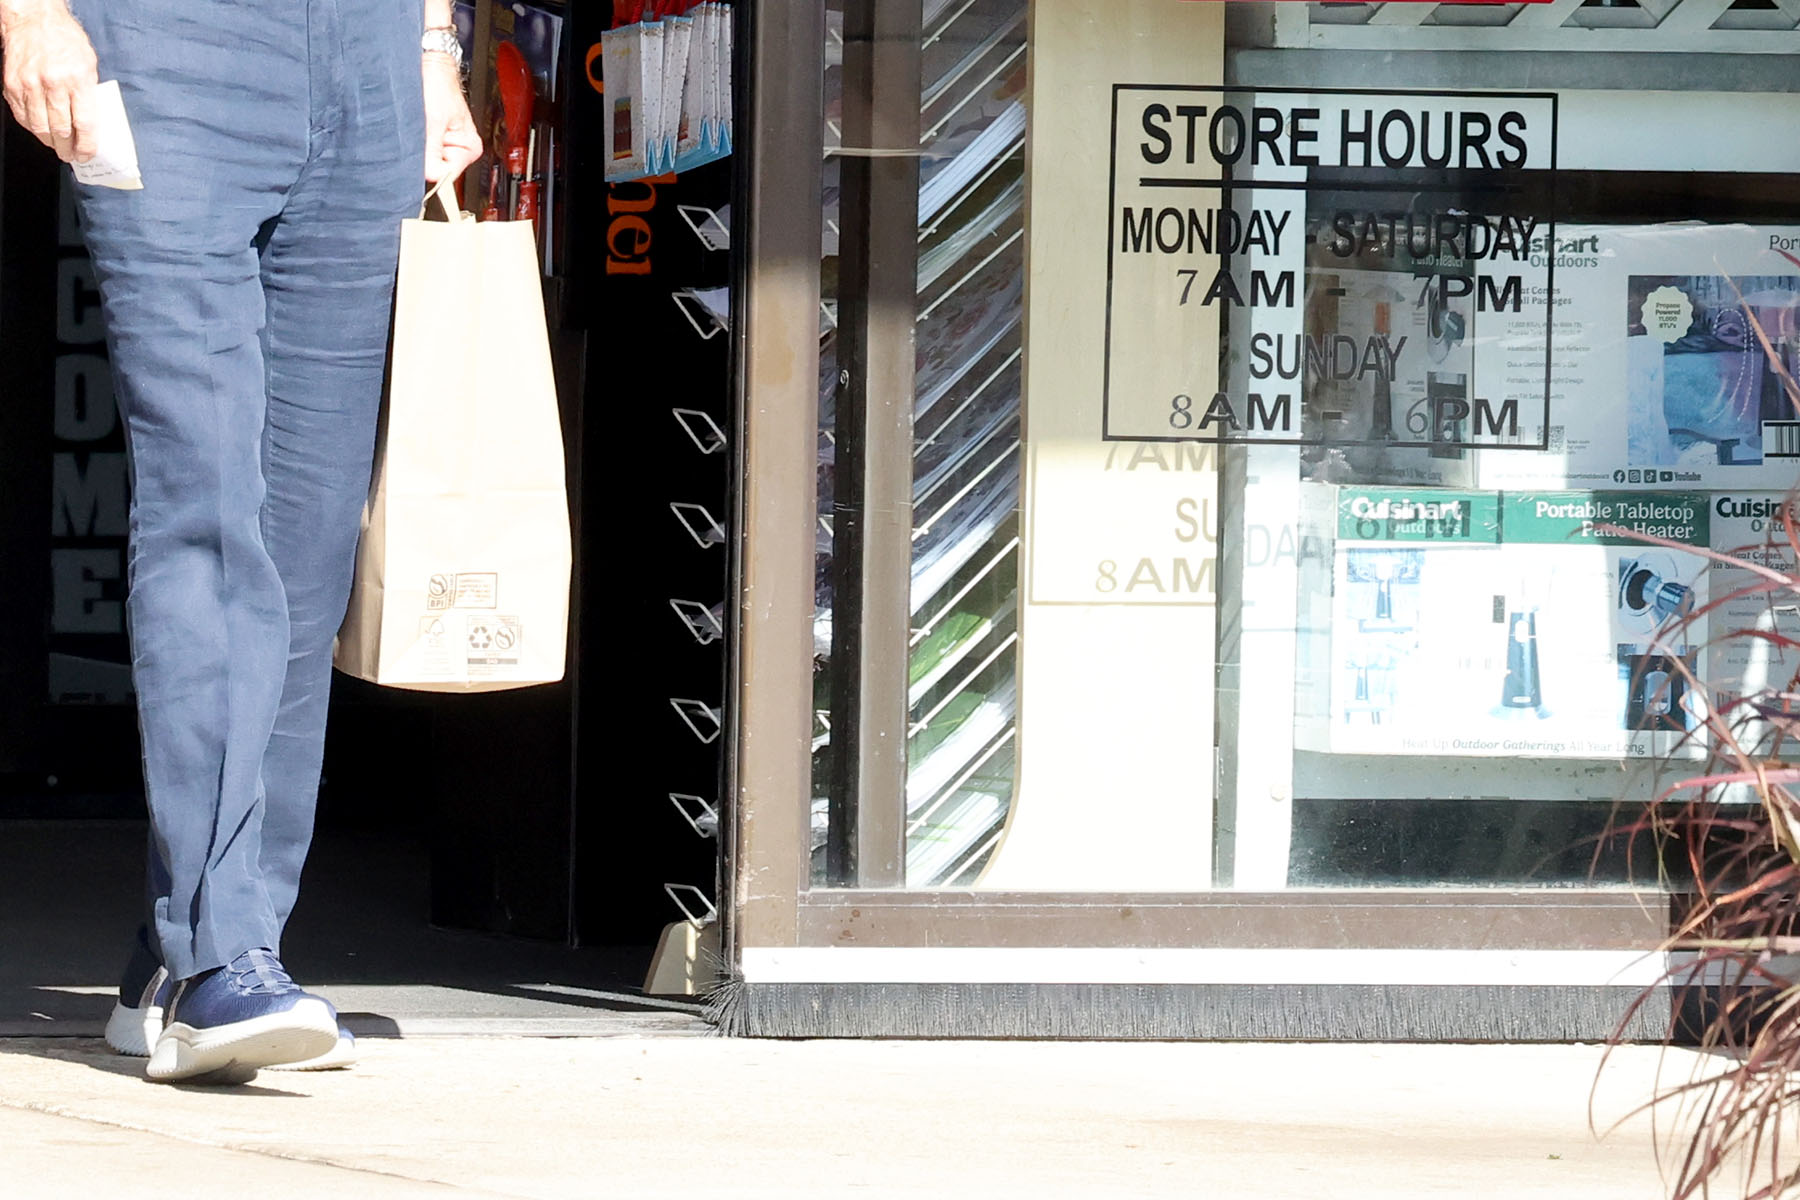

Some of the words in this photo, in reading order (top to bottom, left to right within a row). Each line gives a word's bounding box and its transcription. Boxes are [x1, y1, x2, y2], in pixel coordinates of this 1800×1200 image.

[1140, 103, 1321, 166] STORE
[1340, 107, 1528, 170] HOURS
[1121, 206, 1292, 256] MONDAY
[1330, 209, 1538, 261] SATURDAY
[1176, 269, 1295, 308] 7AM
[1412, 274, 1523, 313] 7PM
[1655, 302, 1681, 310] Propane
[1248, 332, 1409, 383] SUNDAY
[1168, 393, 1292, 432] 8AM
[1406, 396, 1518, 436] 6PM
[1674, 472, 1702, 482] YouTube
[1351, 496, 1463, 520] Cuisinart
[1536, 501, 1612, 519] Portable
[1616, 502, 1694, 523] Tabletop
[1582, 520, 1628, 538] Patio
[1632, 521, 1695, 539] Heater
[430, 600, 444, 608] BPI
[1452, 738, 1500, 750] Outdoor
[1503, 740, 1566, 753] Gatherings
